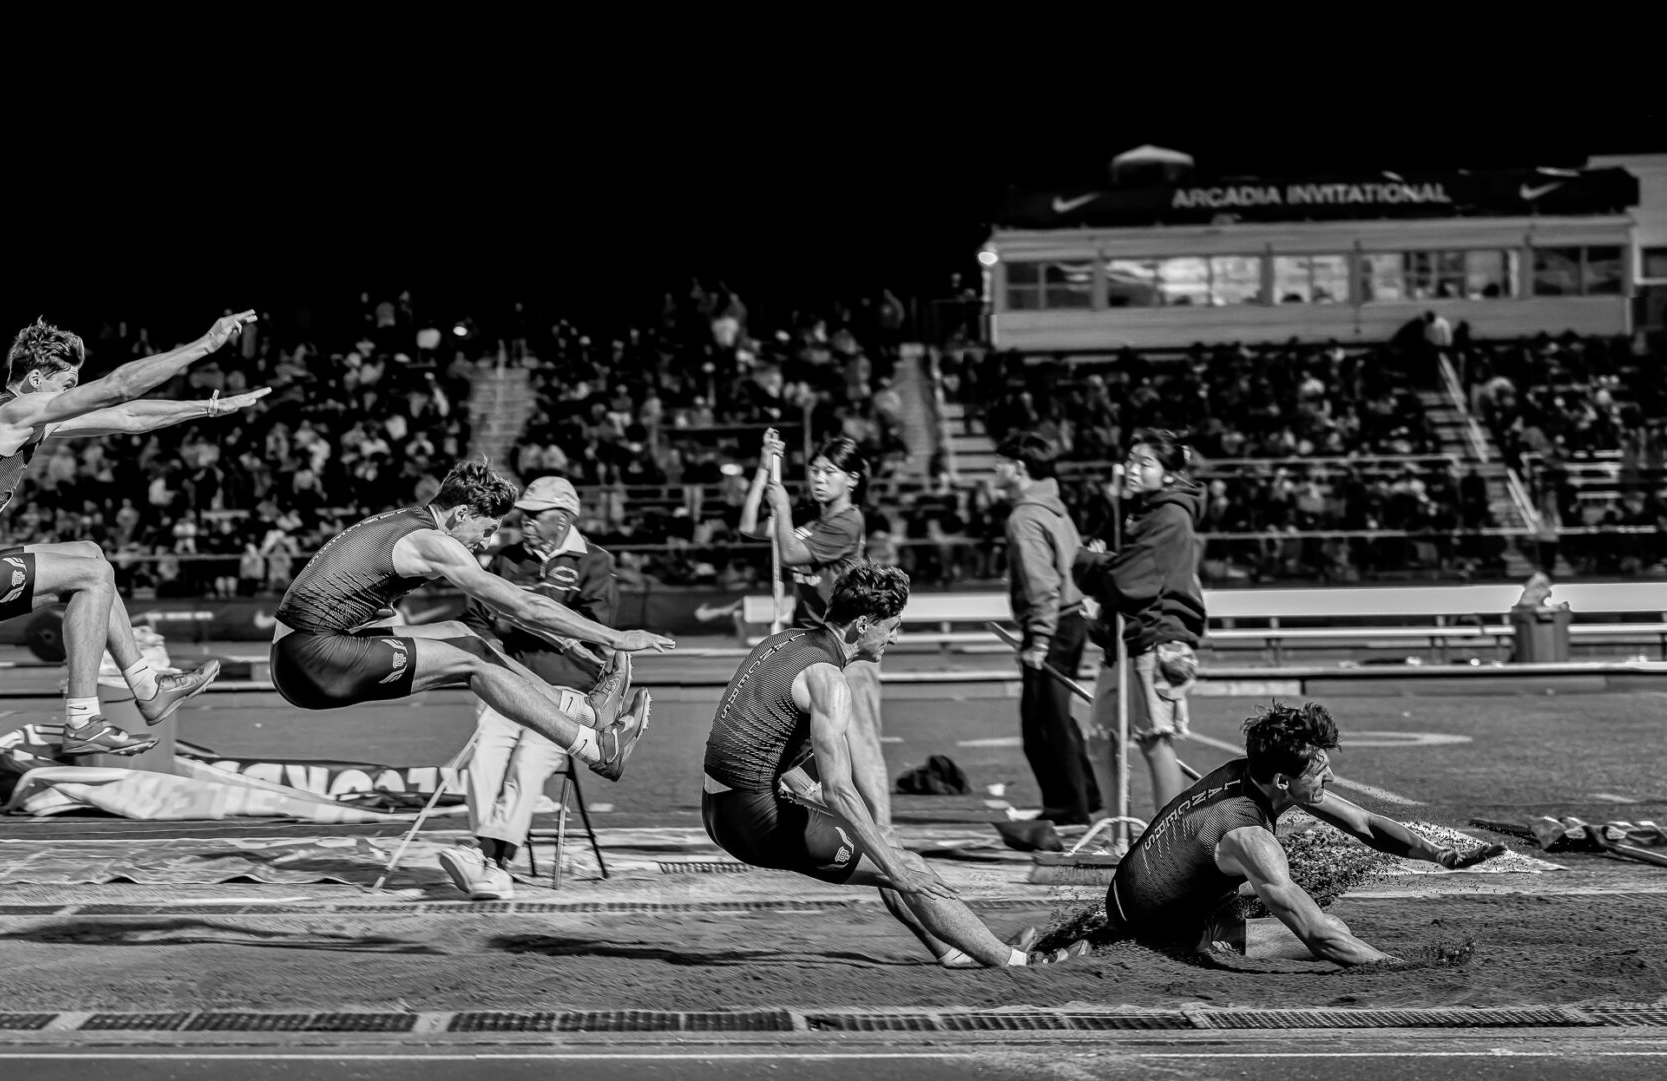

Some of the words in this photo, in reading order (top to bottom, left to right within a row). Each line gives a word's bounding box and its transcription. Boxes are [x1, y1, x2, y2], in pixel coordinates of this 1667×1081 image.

[1172, 185, 1282, 208] ARCADIA
[1286, 182, 1453, 204] INVITATIONAL
[721, 632, 806, 719] LANCERS
[1144, 779, 1241, 851] LANCERS
